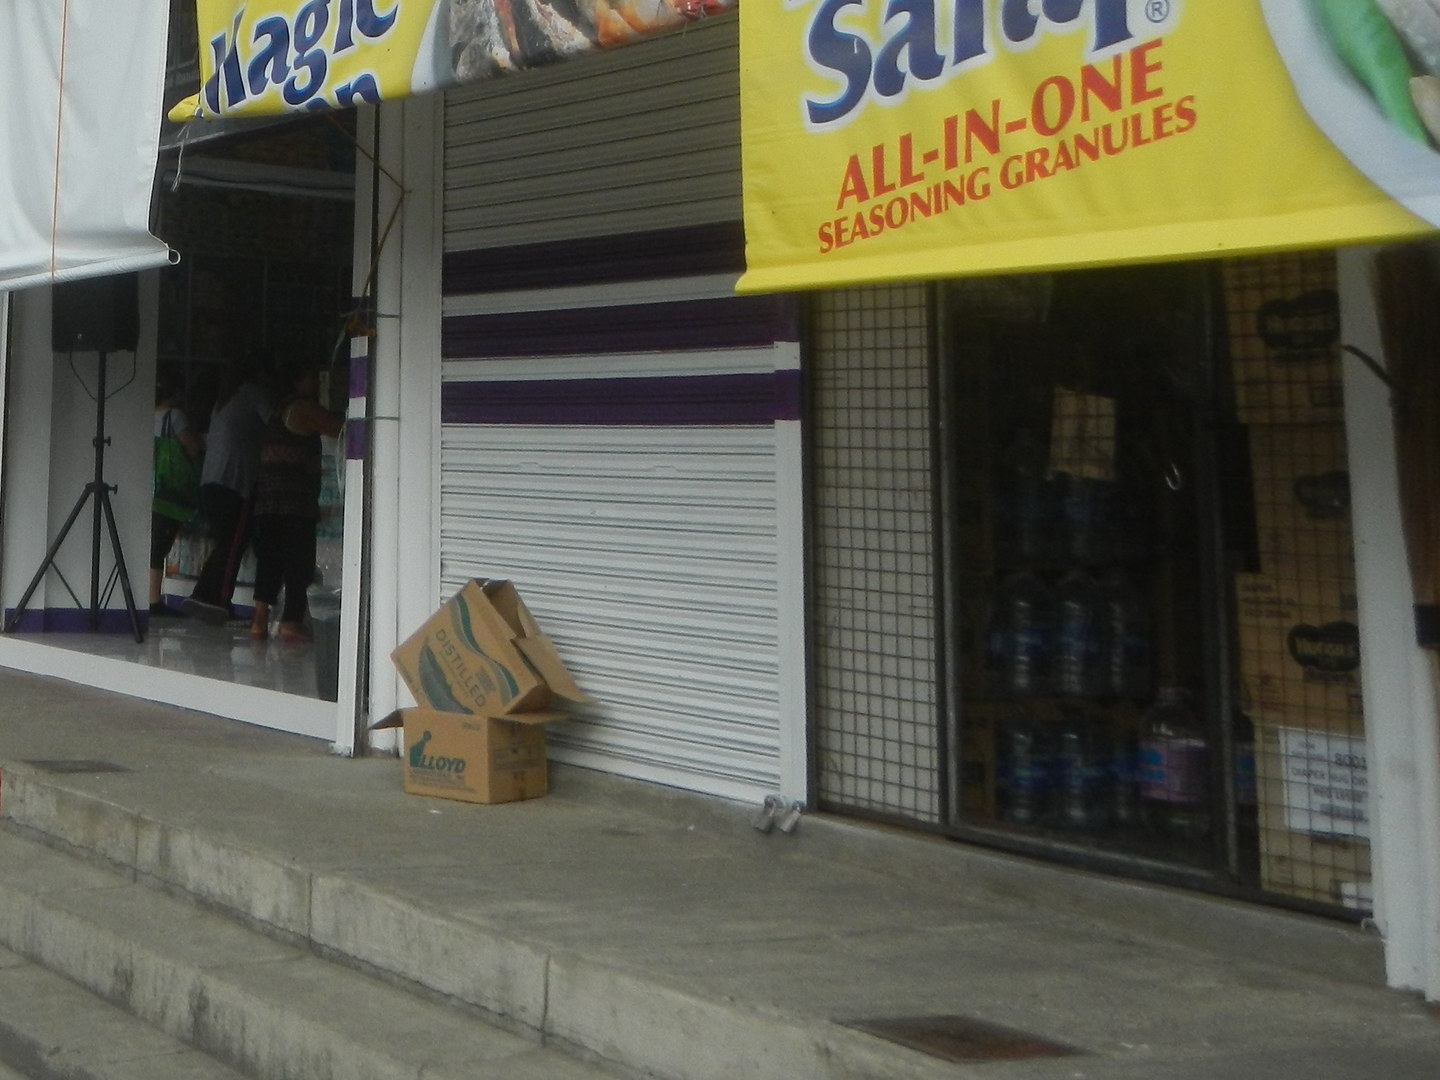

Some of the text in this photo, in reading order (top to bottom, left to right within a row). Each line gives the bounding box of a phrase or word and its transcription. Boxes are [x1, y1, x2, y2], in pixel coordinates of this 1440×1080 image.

[818, 94, 1198, 255] SEASONING GRANULES
[835, 37, 1164, 211] ALL-IN-ONE
[435, 628, 487, 708] DISTILLED
[421, 754, 466, 773] LLOYD
